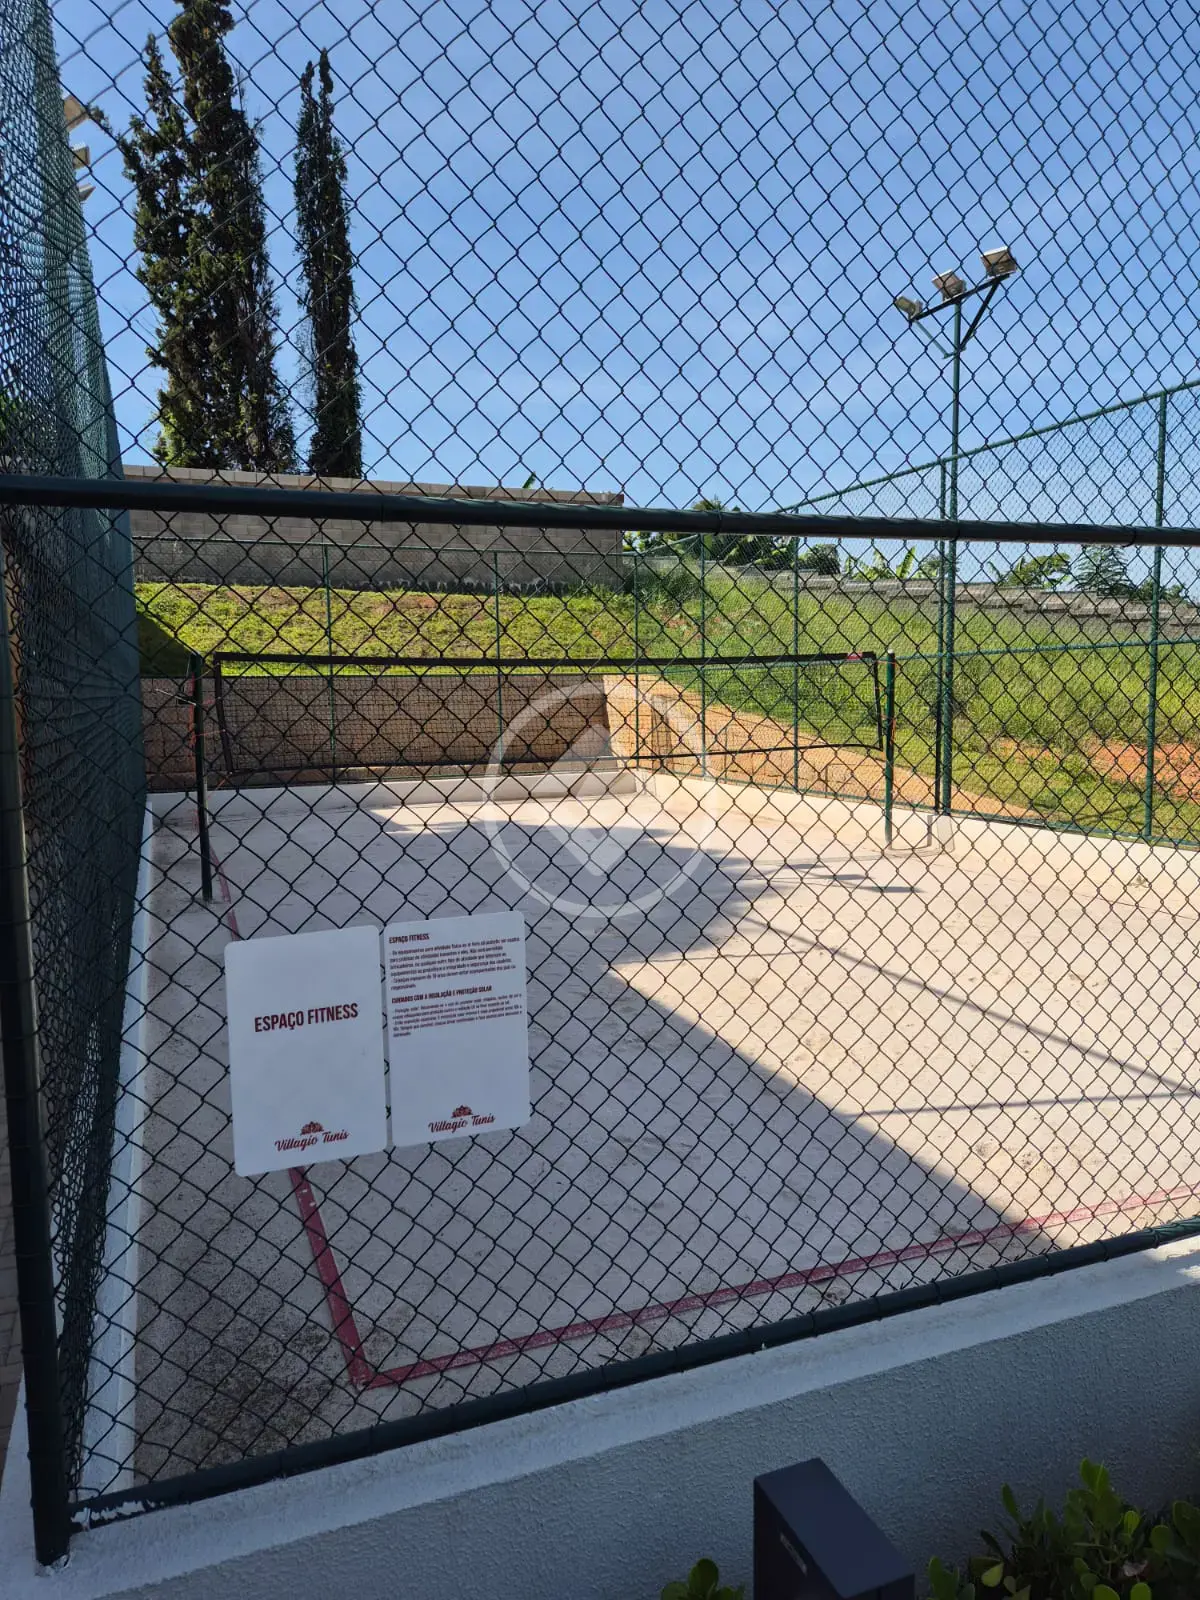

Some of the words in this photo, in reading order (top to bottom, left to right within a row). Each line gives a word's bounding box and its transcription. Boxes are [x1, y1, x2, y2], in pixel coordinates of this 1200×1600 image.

[389, 936, 408, 944] ESPAÇO
[409, 933, 430, 941] FITNESS
[478, 985, 492, 993] SOLAR
[254, 1010, 304, 1033] ESPAÇO
[308, 1002, 359, 1024] FITNESS
[428, 1118, 468, 1134] Villagio
[471, 1113, 496, 1126] Tunis
[275, 1135, 318, 1151] Villagio
[321, 1129, 349, 1143] Tunis
